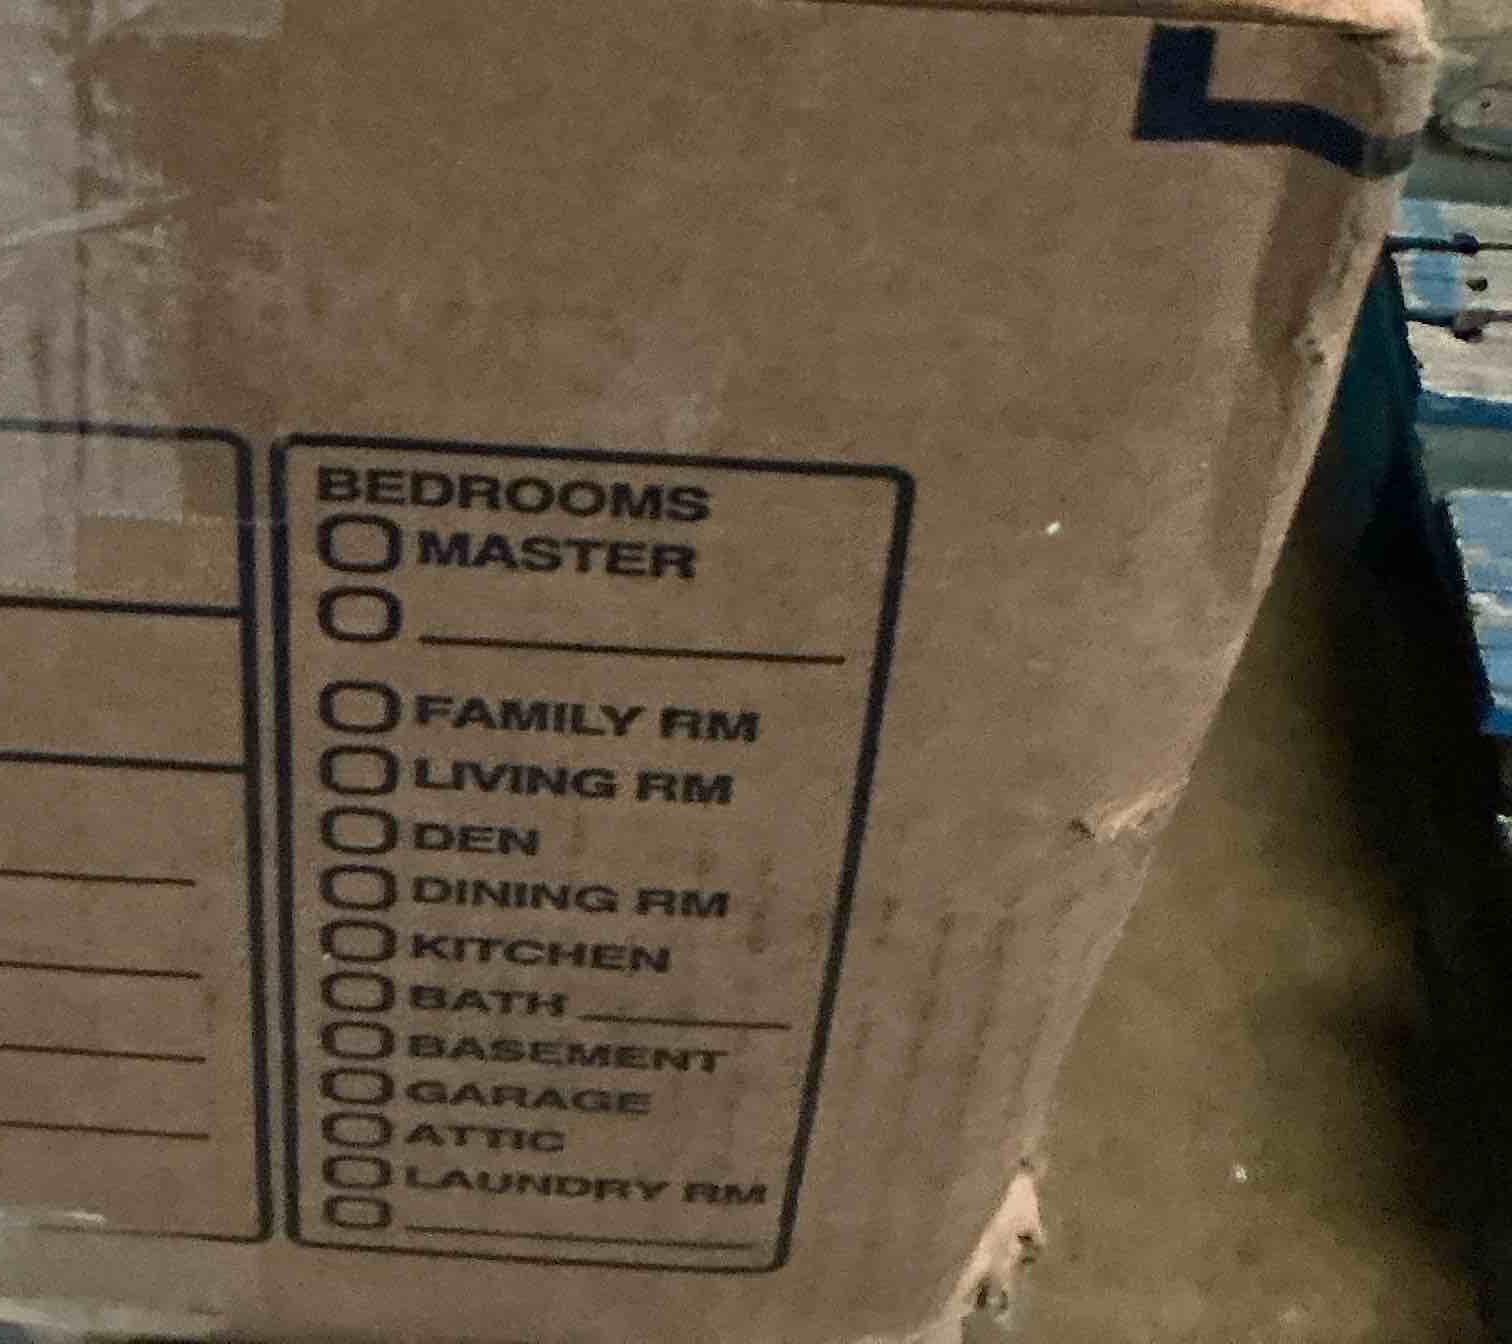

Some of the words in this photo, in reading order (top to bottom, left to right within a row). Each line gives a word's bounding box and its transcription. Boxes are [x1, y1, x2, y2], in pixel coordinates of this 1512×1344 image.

[317, 465, 712, 523] BEDROOMS
[416, 529, 698, 579] MASTER
[415, 693, 646, 738] FAMILY
[659, 706, 762, 745] RM
[416, 757, 620, 800] LIVING
[636, 769, 736, 806] RM
[414, 821, 541, 857] DEN
[412, 875, 620, 914] DINING
[637, 886, 731, 919] RM
[410, 932, 671, 974] KITCHEN
[408, 984, 571, 1018] BATH
[408, 1033, 729, 1074] BASEMENT
[405, 1081, 653, 1115] GARAGE
[405, 1122, 568, 1154] ATTIC
[406, 1164, 671, 1202] LAUNDRY
[682, 1181, 769, 1205] RM
